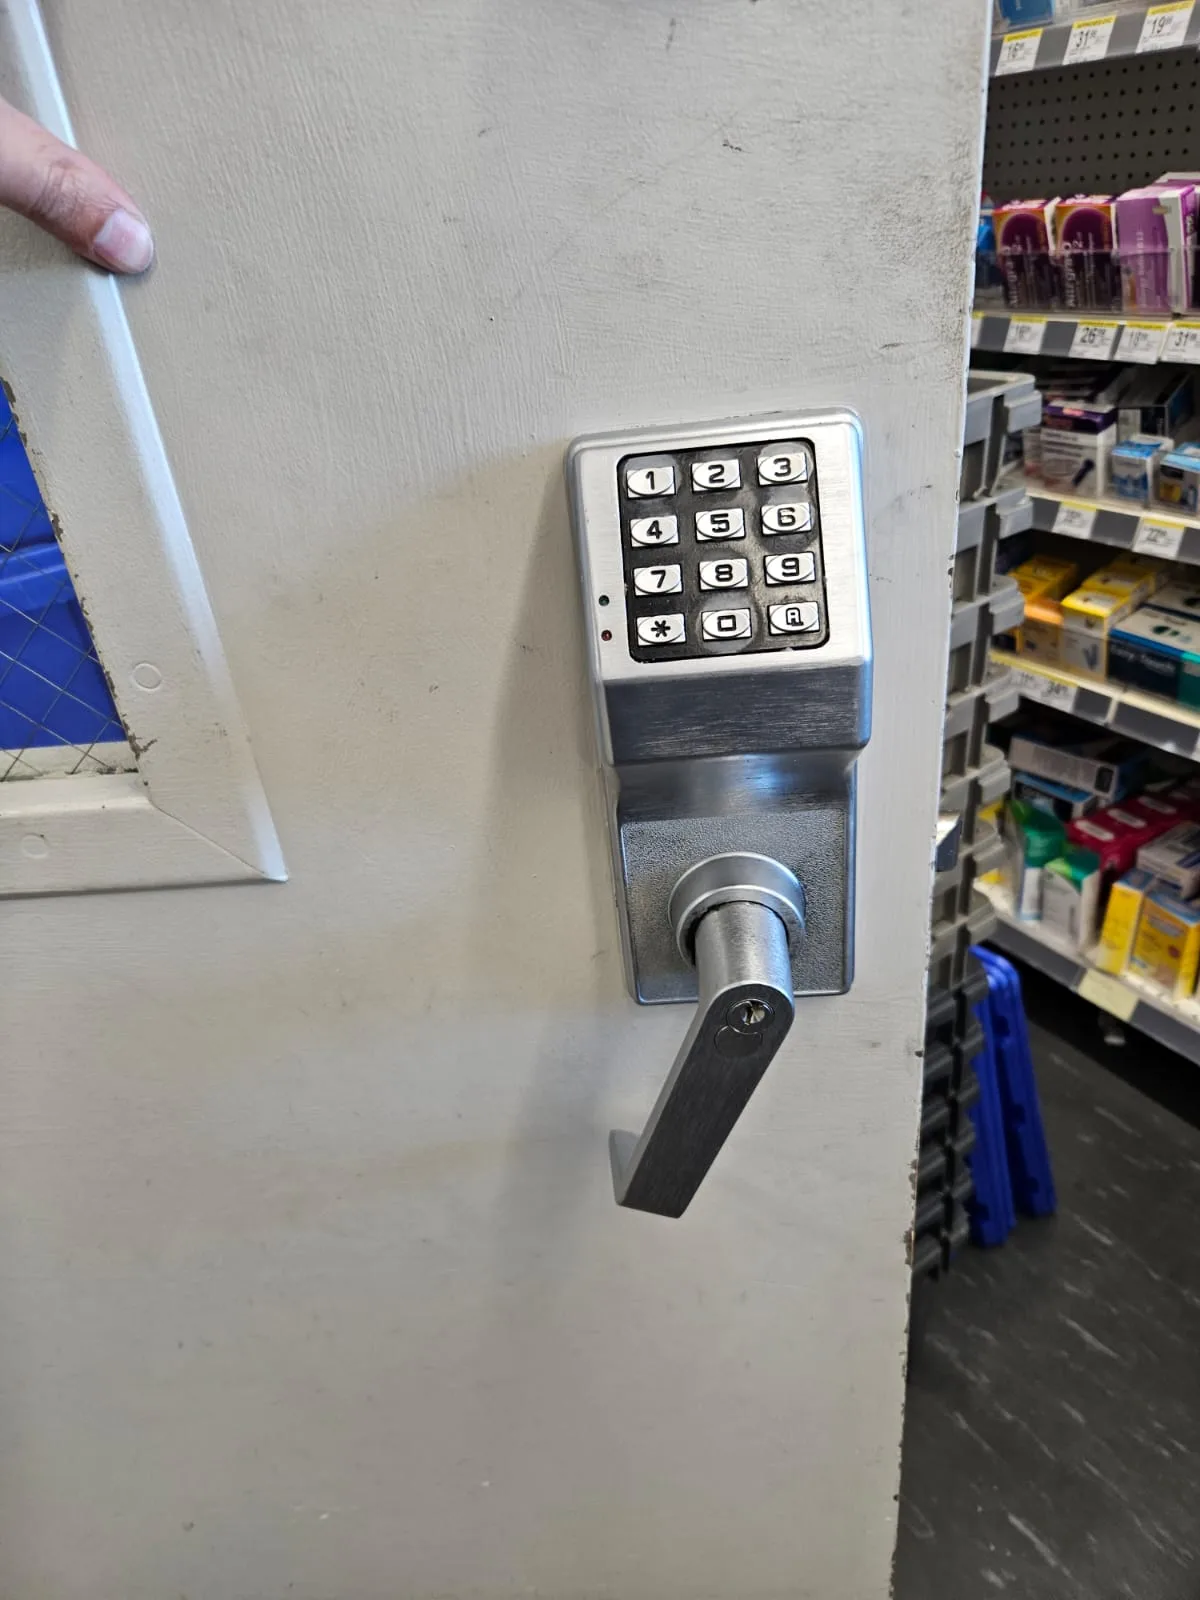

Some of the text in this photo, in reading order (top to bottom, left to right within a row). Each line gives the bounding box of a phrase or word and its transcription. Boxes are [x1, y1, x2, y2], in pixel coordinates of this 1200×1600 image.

[646, 458, 791, 490] 1 2 3
[646, 507, 796, 540] 4 5 6
[650, 558, 801, 589] 7 8 9
